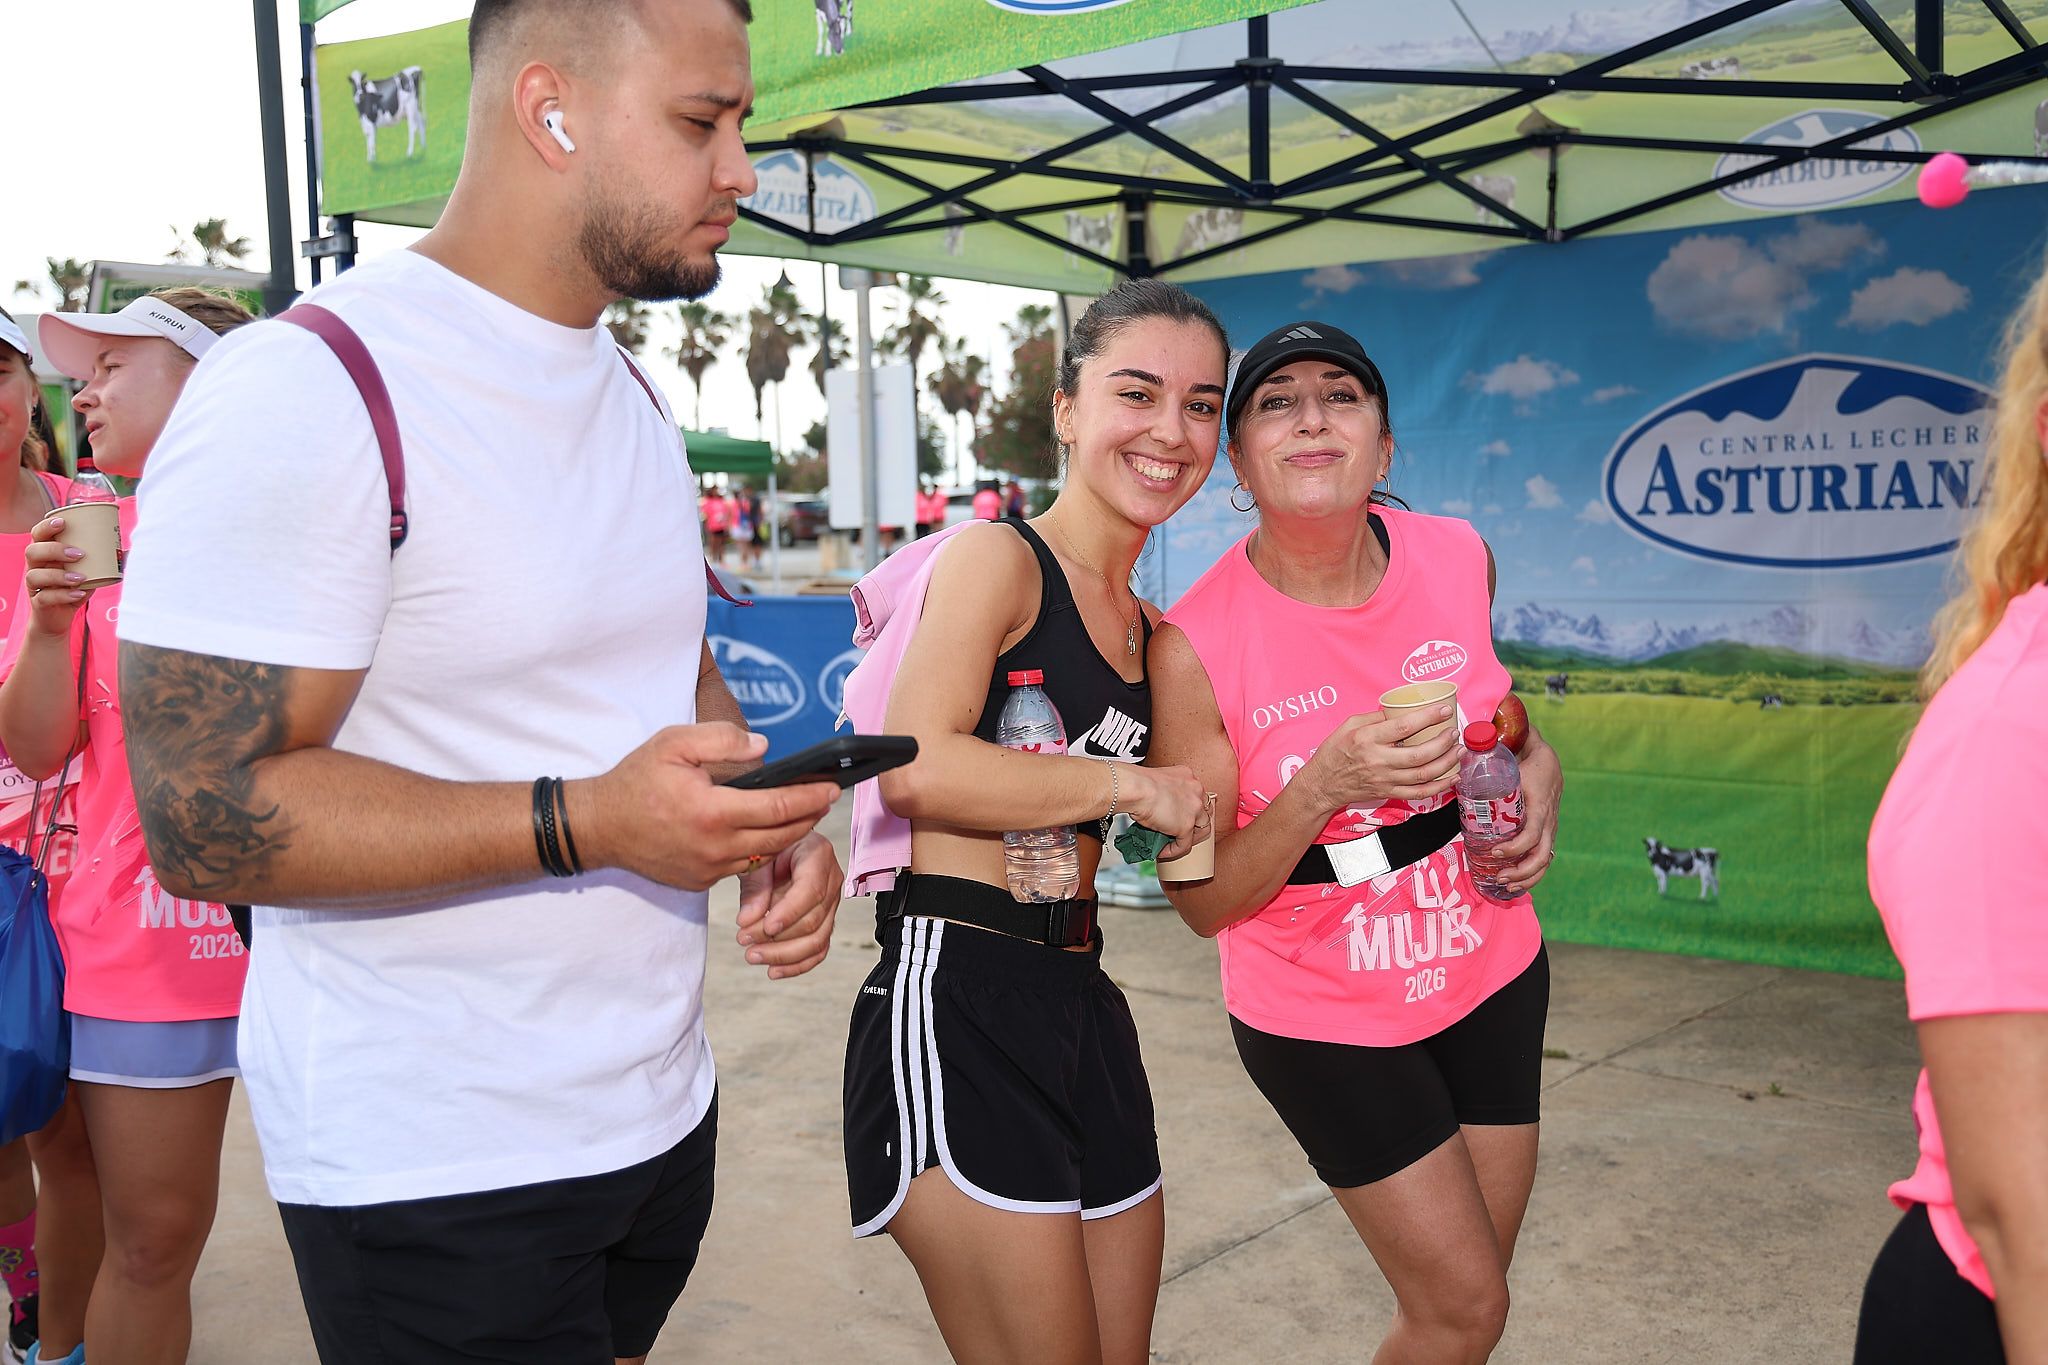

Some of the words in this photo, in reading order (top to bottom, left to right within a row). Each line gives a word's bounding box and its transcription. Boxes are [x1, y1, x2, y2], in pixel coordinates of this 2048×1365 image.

[149, 311, 187, 331] KIPRUN
[1700, 432, 1834, 456] CENTRAL
[1408, 652, 1464, 680] ASTURIANA
[1252, 685, 1338, 729] OYSHO
[1089, 705, 1148, 758] NIKE
[189, 932, 245, 960] 2026
[1346, 904, 1483, 972] MUJER
[1404, 966, 1447, 1004] 2026
